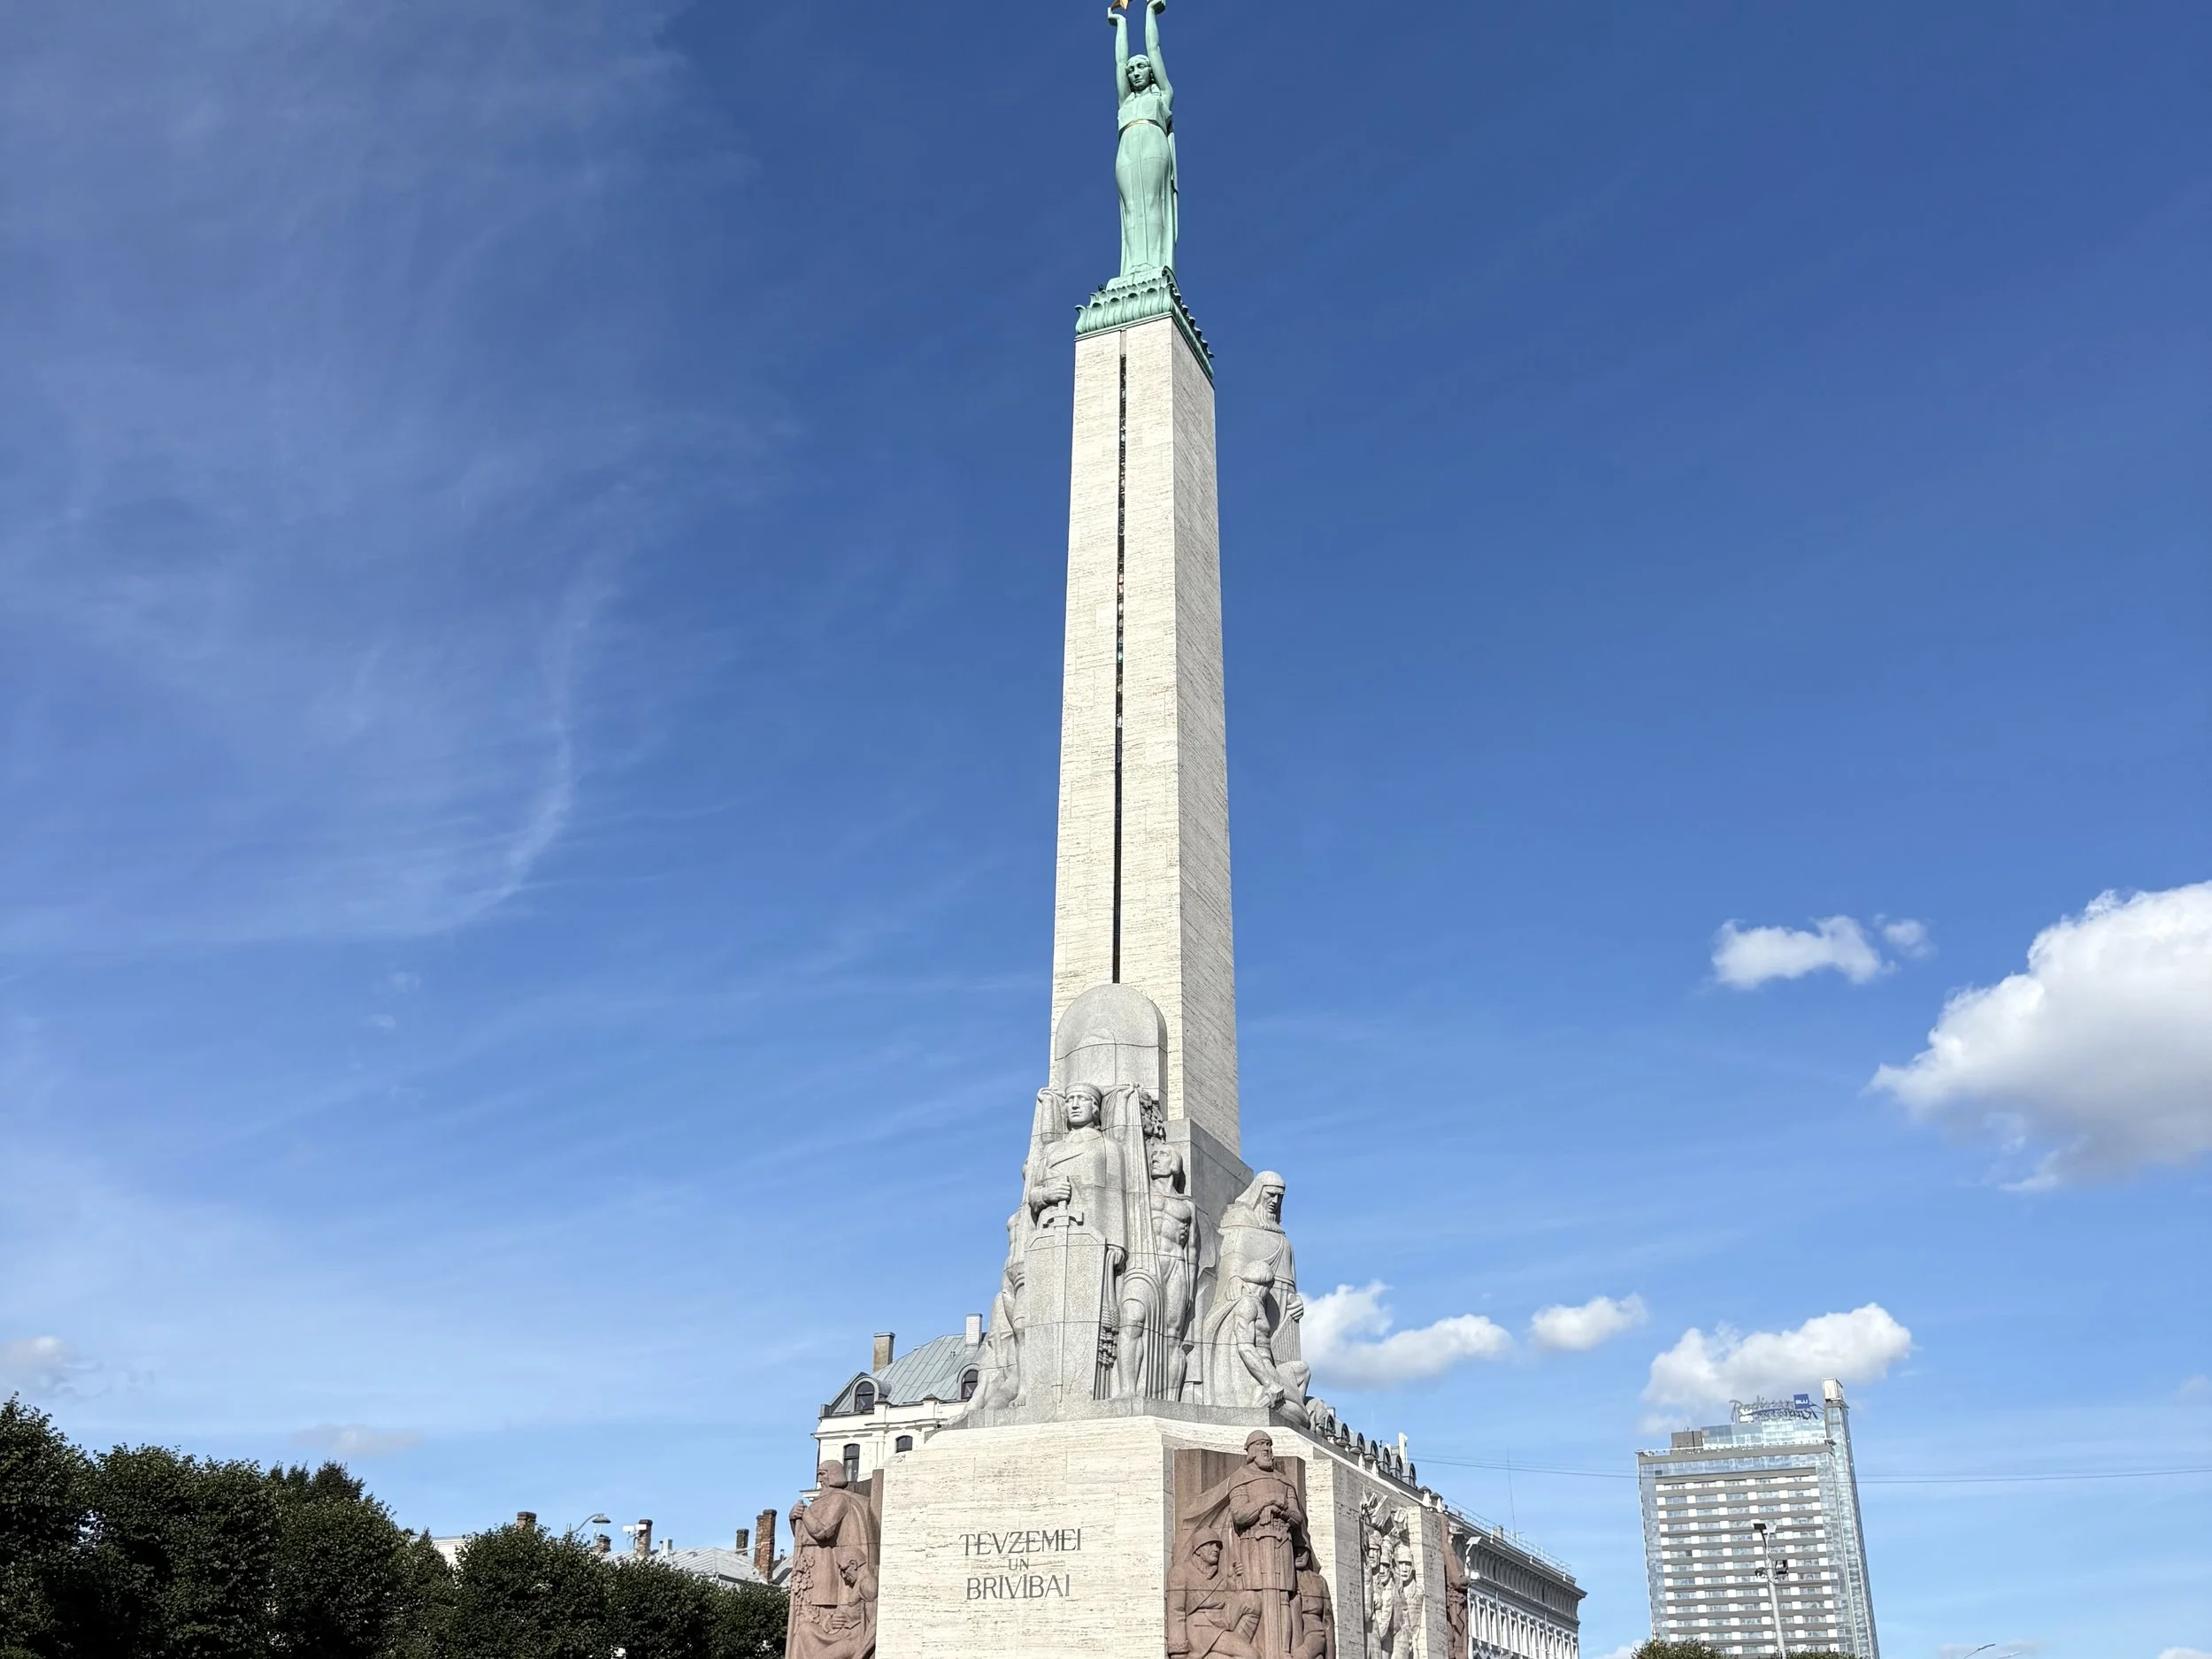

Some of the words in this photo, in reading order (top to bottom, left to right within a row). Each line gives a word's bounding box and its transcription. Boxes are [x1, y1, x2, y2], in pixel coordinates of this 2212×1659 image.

[959, 1528, 1081, 1555] TĒVZEMEI
[1008, 1558, 1029, 1571] UN
[966, 1574, 1070, 1600] BRĪVĪBAI
